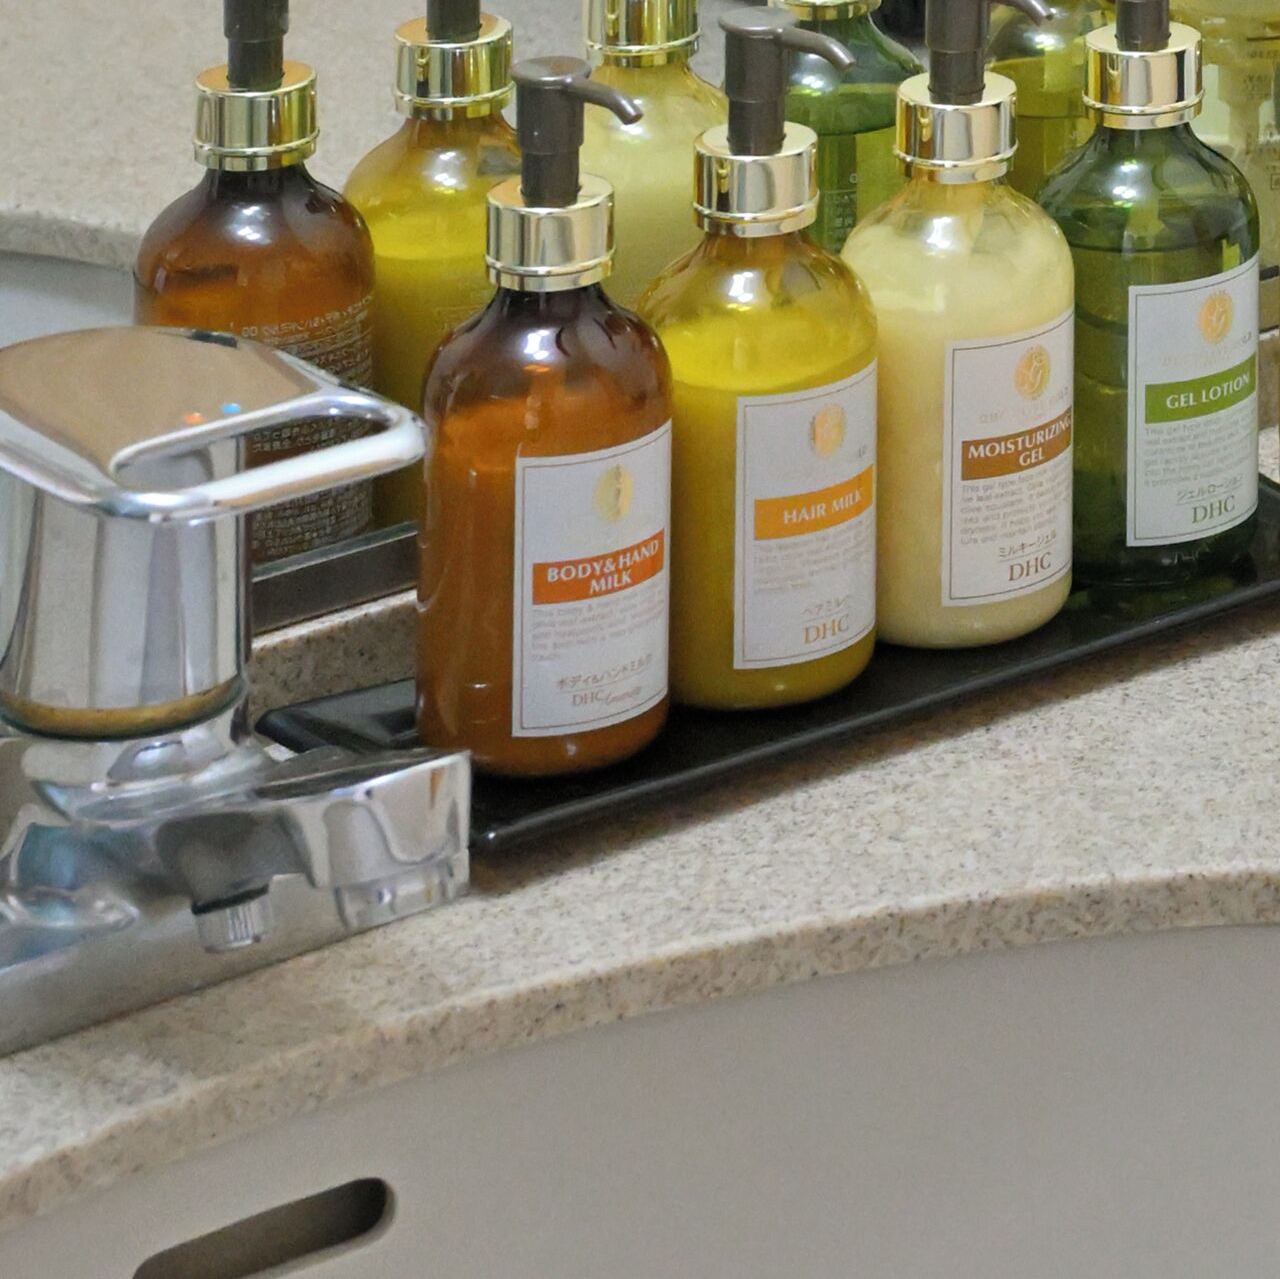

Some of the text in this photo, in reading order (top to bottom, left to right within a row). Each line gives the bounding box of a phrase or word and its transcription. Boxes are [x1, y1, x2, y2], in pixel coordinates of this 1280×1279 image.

[1166, 372, 1250, 409] GEL LOTION
[968, 415, 1072, 459] MOISTURIZING
[1019, 447, 1044, 467] GEL
[783, 489, 862, 524] HAIR MILK
[1192, 495, 1236, 524] DHC
[589, 569, 632, 595] MILK
[1008, 552, 1052, 582] DHC
[803, 614, 849, 645] DHC
[572, 690, 606, 707] DHC
